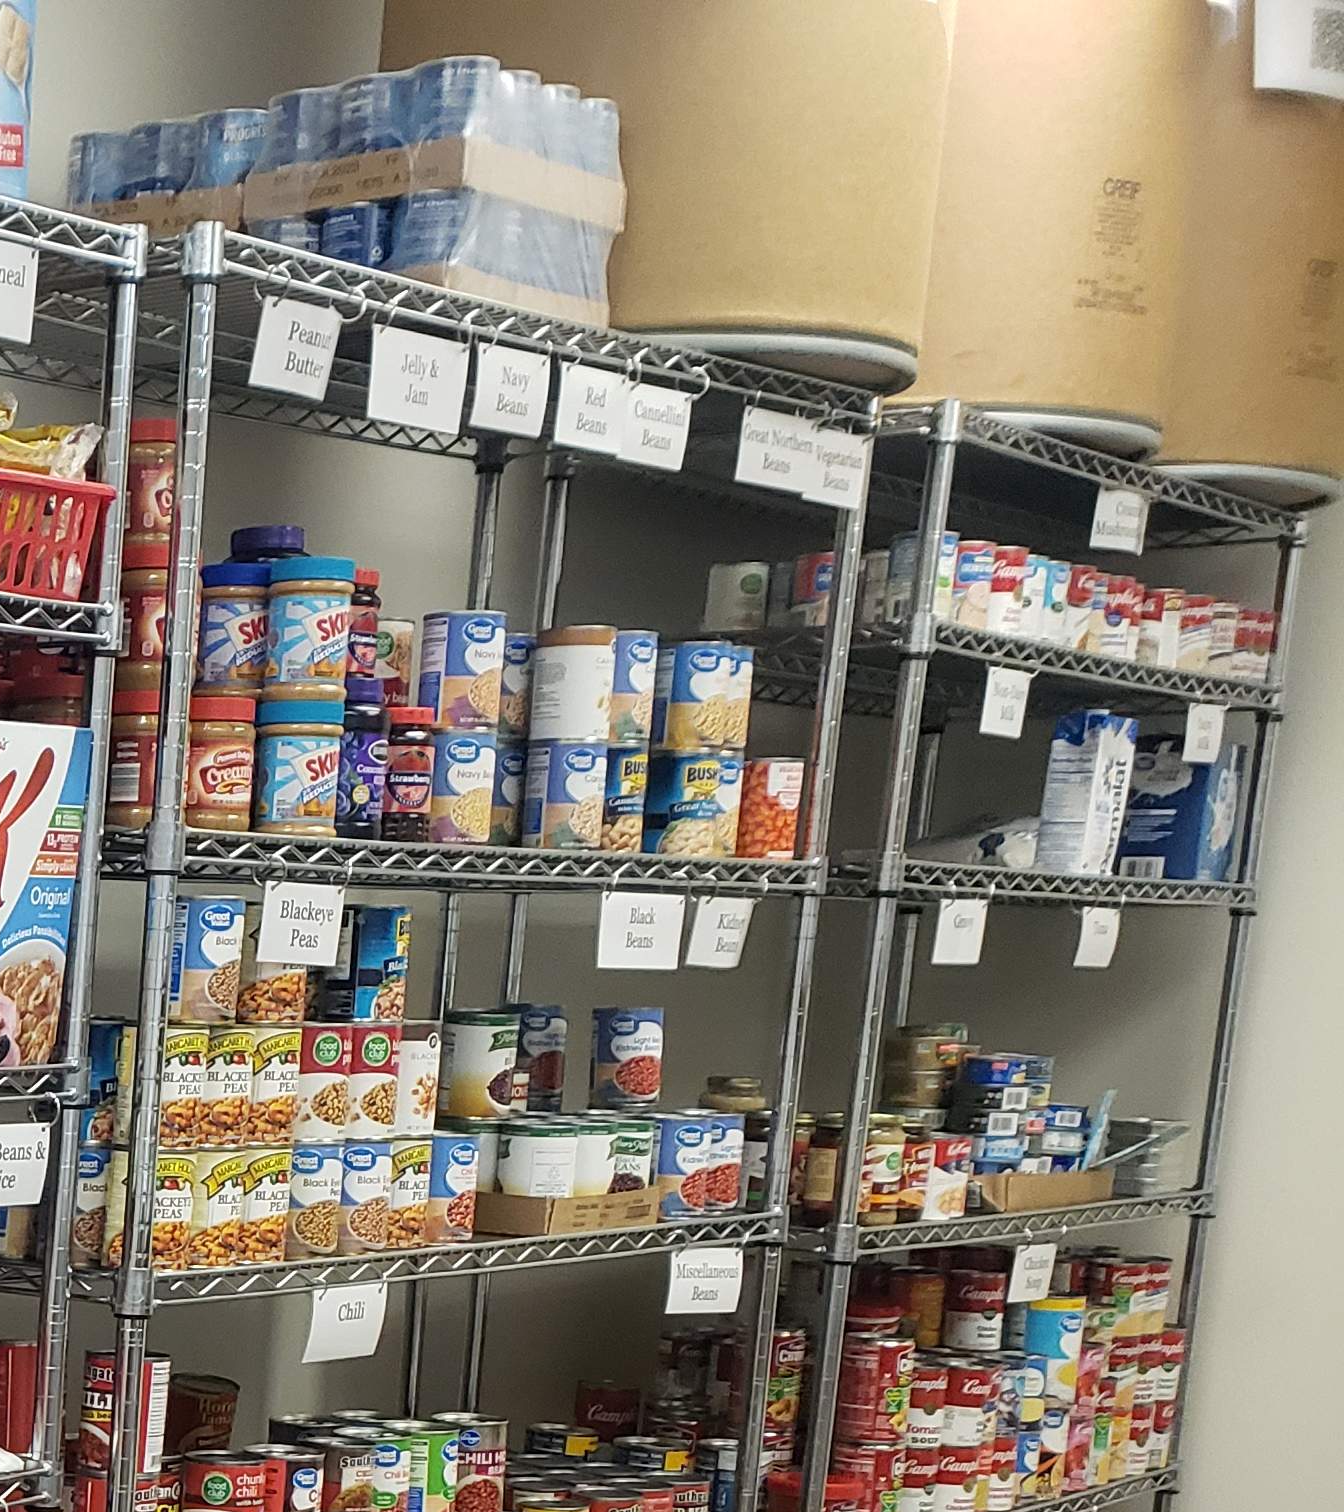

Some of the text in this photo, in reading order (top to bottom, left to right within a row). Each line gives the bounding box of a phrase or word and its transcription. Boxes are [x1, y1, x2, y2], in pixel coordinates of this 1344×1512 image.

[285, 351, 324, 379] Butter
[401, 353, 440, 381] Jelly &
[501, 365, 530, 389] Navy
[405, 384, 429, 406] Jam
[496, 393, 529, 416] Beans
[585, 387, 607, 408] Red
[634, 400, 686, 425] Cannellini
[576, 413, 608, 436] Beans
[642, 429, 672, 450] Beans
[763, 453, 792, 474] Beans
[31, 886, 70, 908] Original
[280, 900, 334, 923] Blackeye
[630, 907, 656, 924] Black
[290, 929, 319, 948] Peas
[626, 931, 654, 948] Beans
[318, 1040, 339, 1050] food
[32, 1142, 46, 1161] &
[303, 1177, 329, 1187] Black
[357, 1175, 380, 1185] Black
[676, 1263, 739, 1280] Miscellaneous
[691, 1286, 719, 1302] Beans
[337, 1301, 365, 1323] Chili
[457, 1452, 493, 1465] CHILI
[236, 1486, 259, 1498] chili
